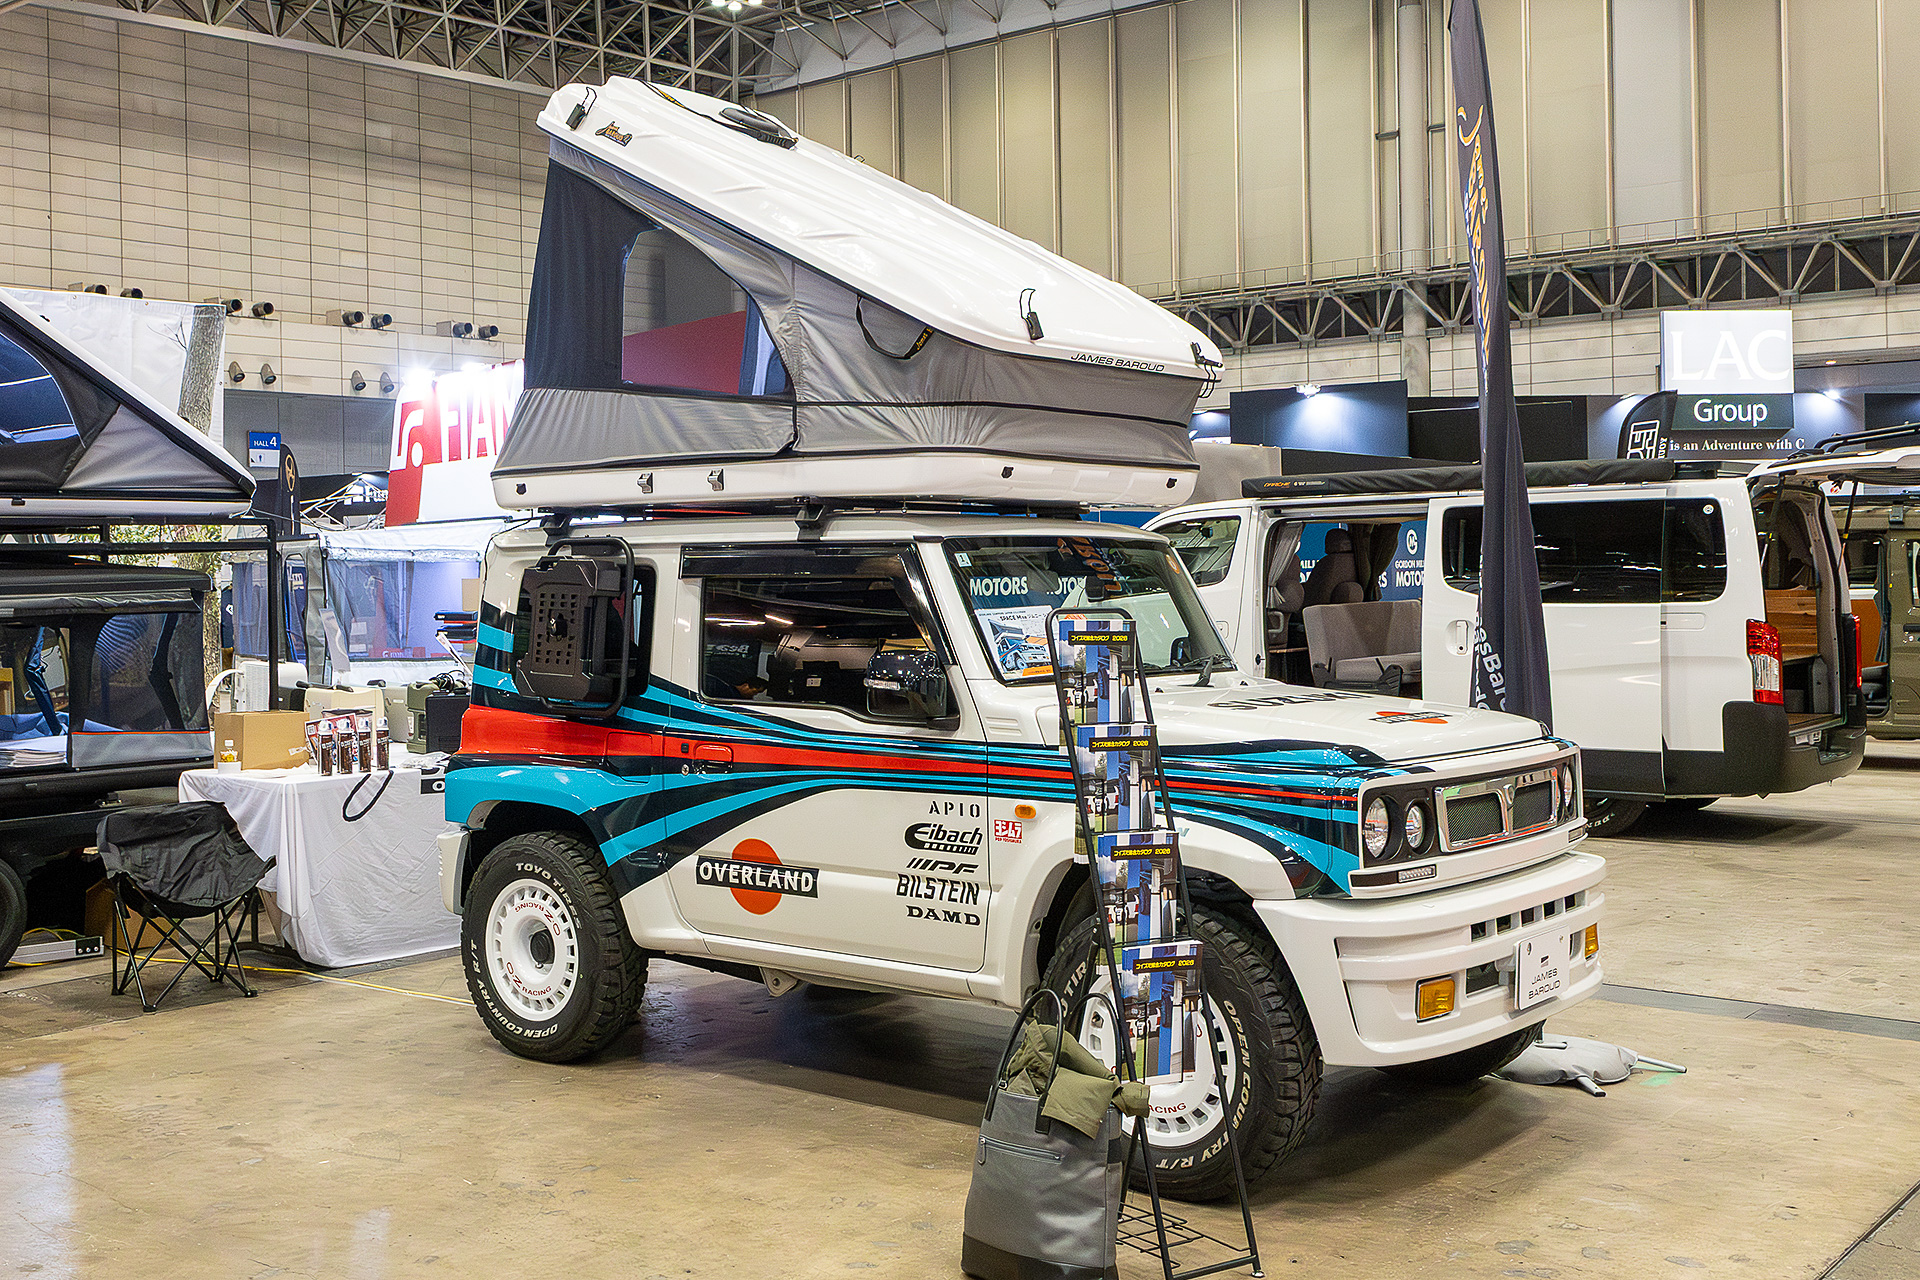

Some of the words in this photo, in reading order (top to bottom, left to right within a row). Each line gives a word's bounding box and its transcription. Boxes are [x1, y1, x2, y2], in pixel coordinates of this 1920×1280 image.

[1071, 353, 1114, 365] JAMES
[1115, 359, 1165, 372] BAROUD
[1671, 329, 1790, 381] LAC
[438, 359, 525, 463] FIAM
[1693, 399, 1769, 427] Group
[270, 437, 277, 447] 4
[1670, 440, 1680, 451] is
[1683, 442, 1698, 451] an
[1702, 440, 1763, 451] Adventure
[1765, 439, 1793, 450] with
[1394, 559, 1415, 569] GORDON
[969, 576, 1029, 596] MOTORS
[929, 800, 980, 818] APIO
[905, 822, 983, 855] Eibach
[995, 820, 1021, 838] ヨシムラ
[699, 861, 814, 892] OVERLAND
[516, 862, 551, 879] TOYO
[553, 877, 582, 930] TIRES
[896, 873, 980, 906] BILSTEIN
[906, 905, 981, 926] DAMD
[1063, 961, 1087, 997] TIR
[1531, 967, 1558, 985] JAMES
[521, 985, 552, 996] RACING
[1528, 979, 1561, 1000] BAROUD
[476, 977, 522, 1036] COUNTRY
[523, 1023, 558, 1039] OPEN
[1223, 1000, 1251, 1068] OPEN
[1148, 1103, 1187, 1114] ACING
[1155, 1155, 1195, 1170] R/T
